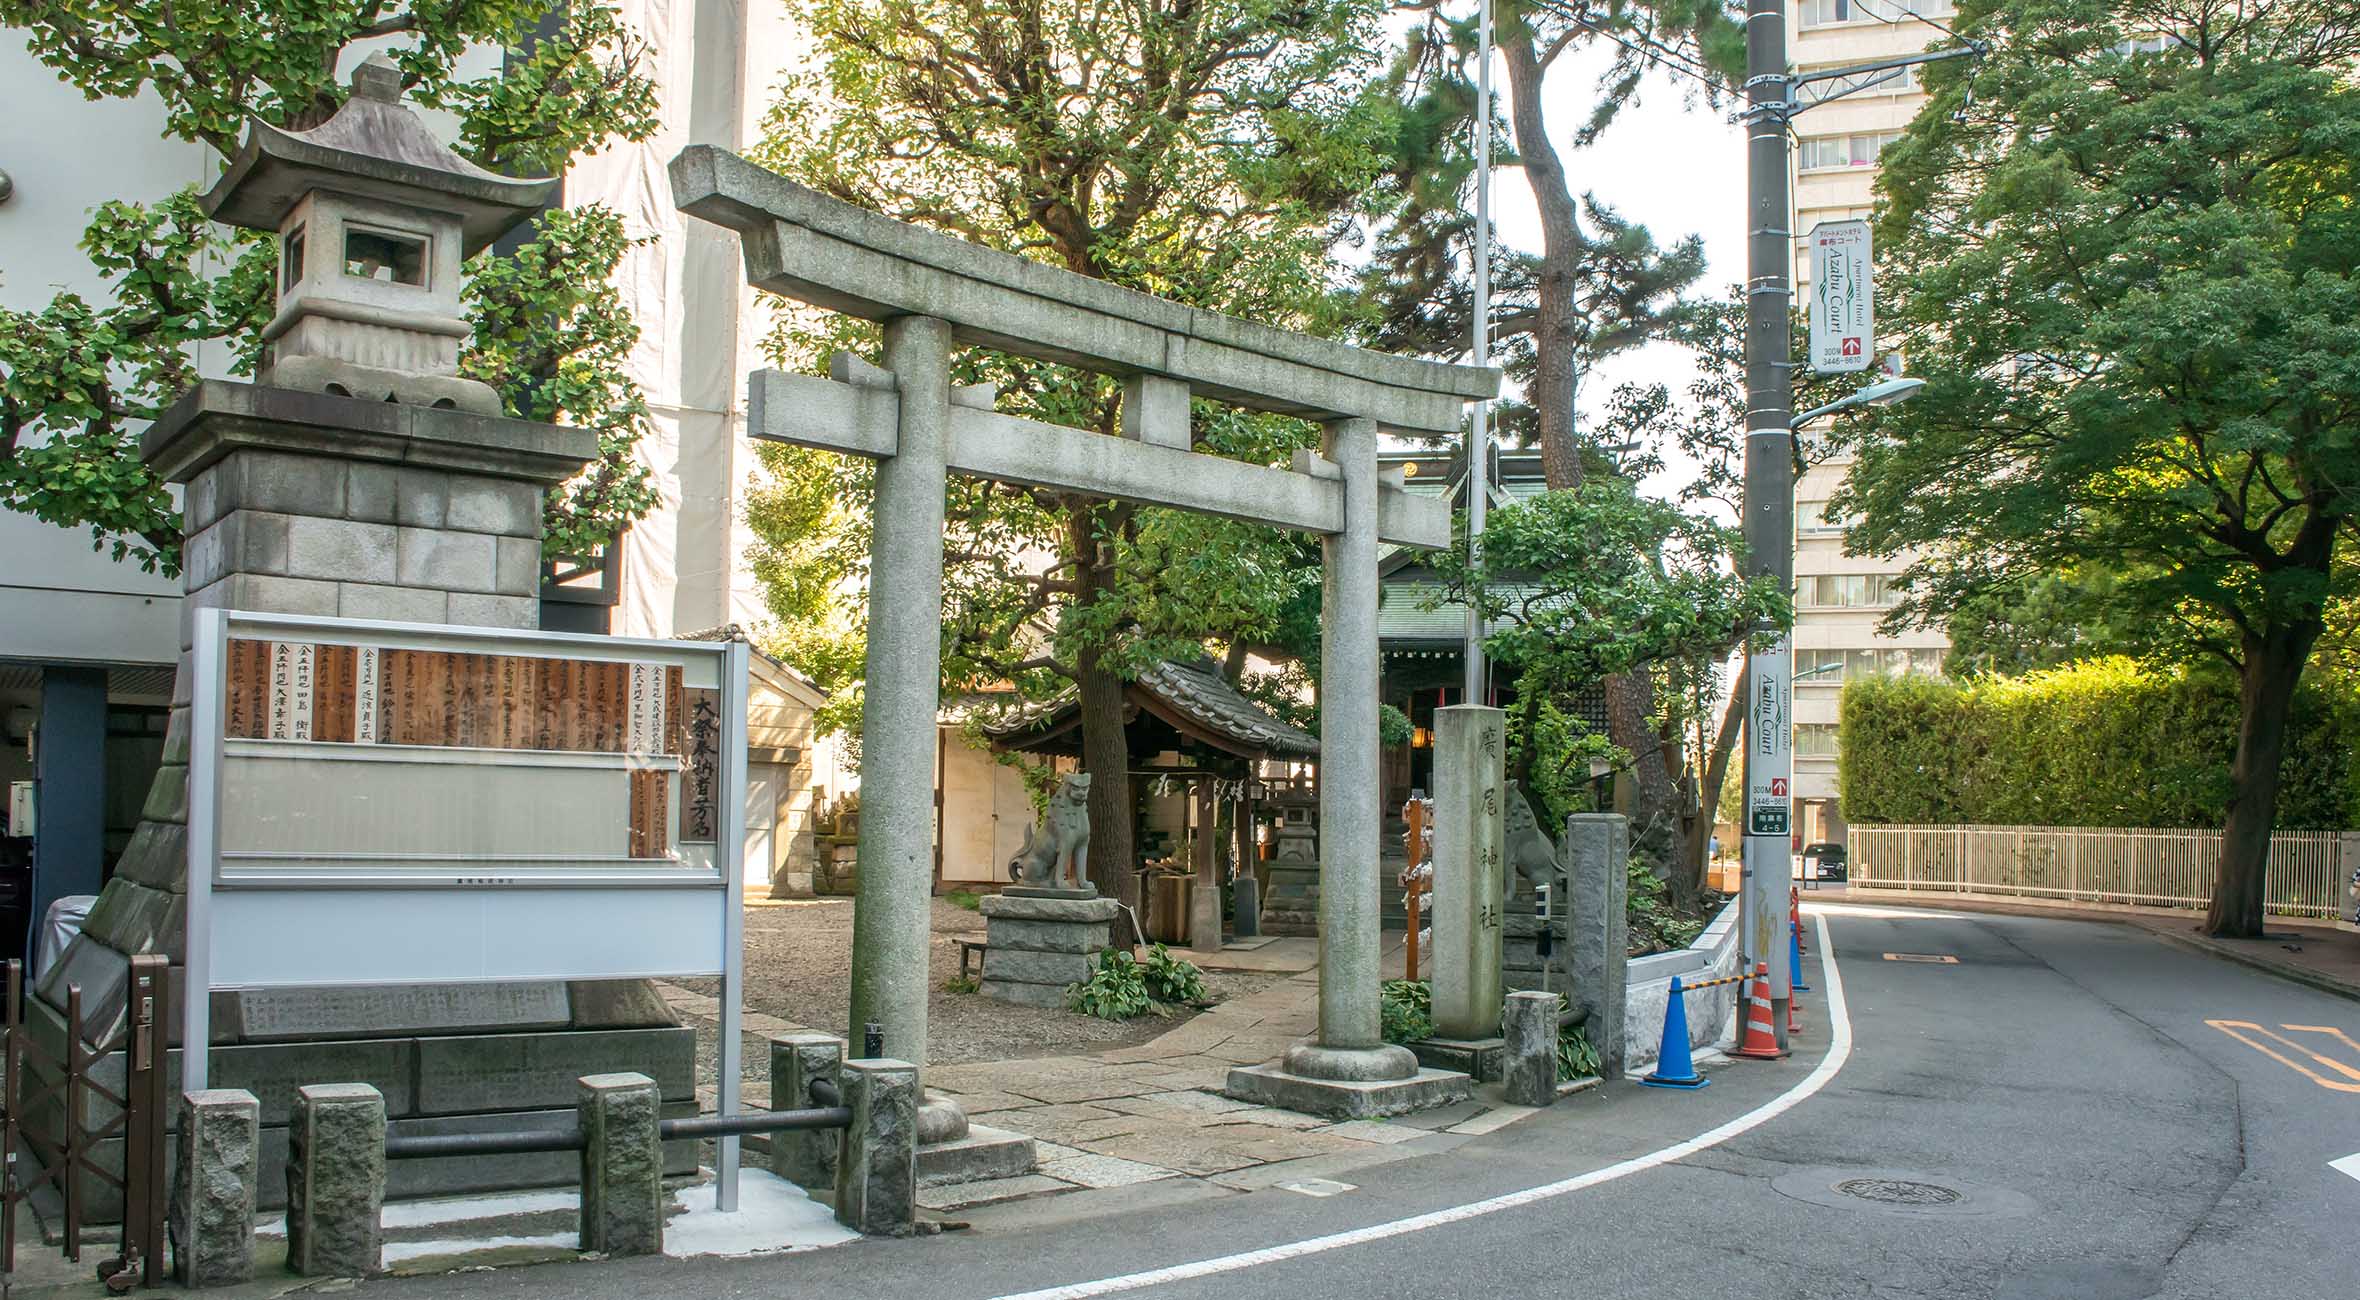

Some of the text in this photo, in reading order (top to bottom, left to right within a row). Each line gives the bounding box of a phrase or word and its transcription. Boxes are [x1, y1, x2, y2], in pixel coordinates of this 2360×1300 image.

[1830, 248, 1843, 333] Azabu Court
[1853, 259, 1864, 327] Apartment Hotel
[1762, 674, 1775, 755] Azabu Court
